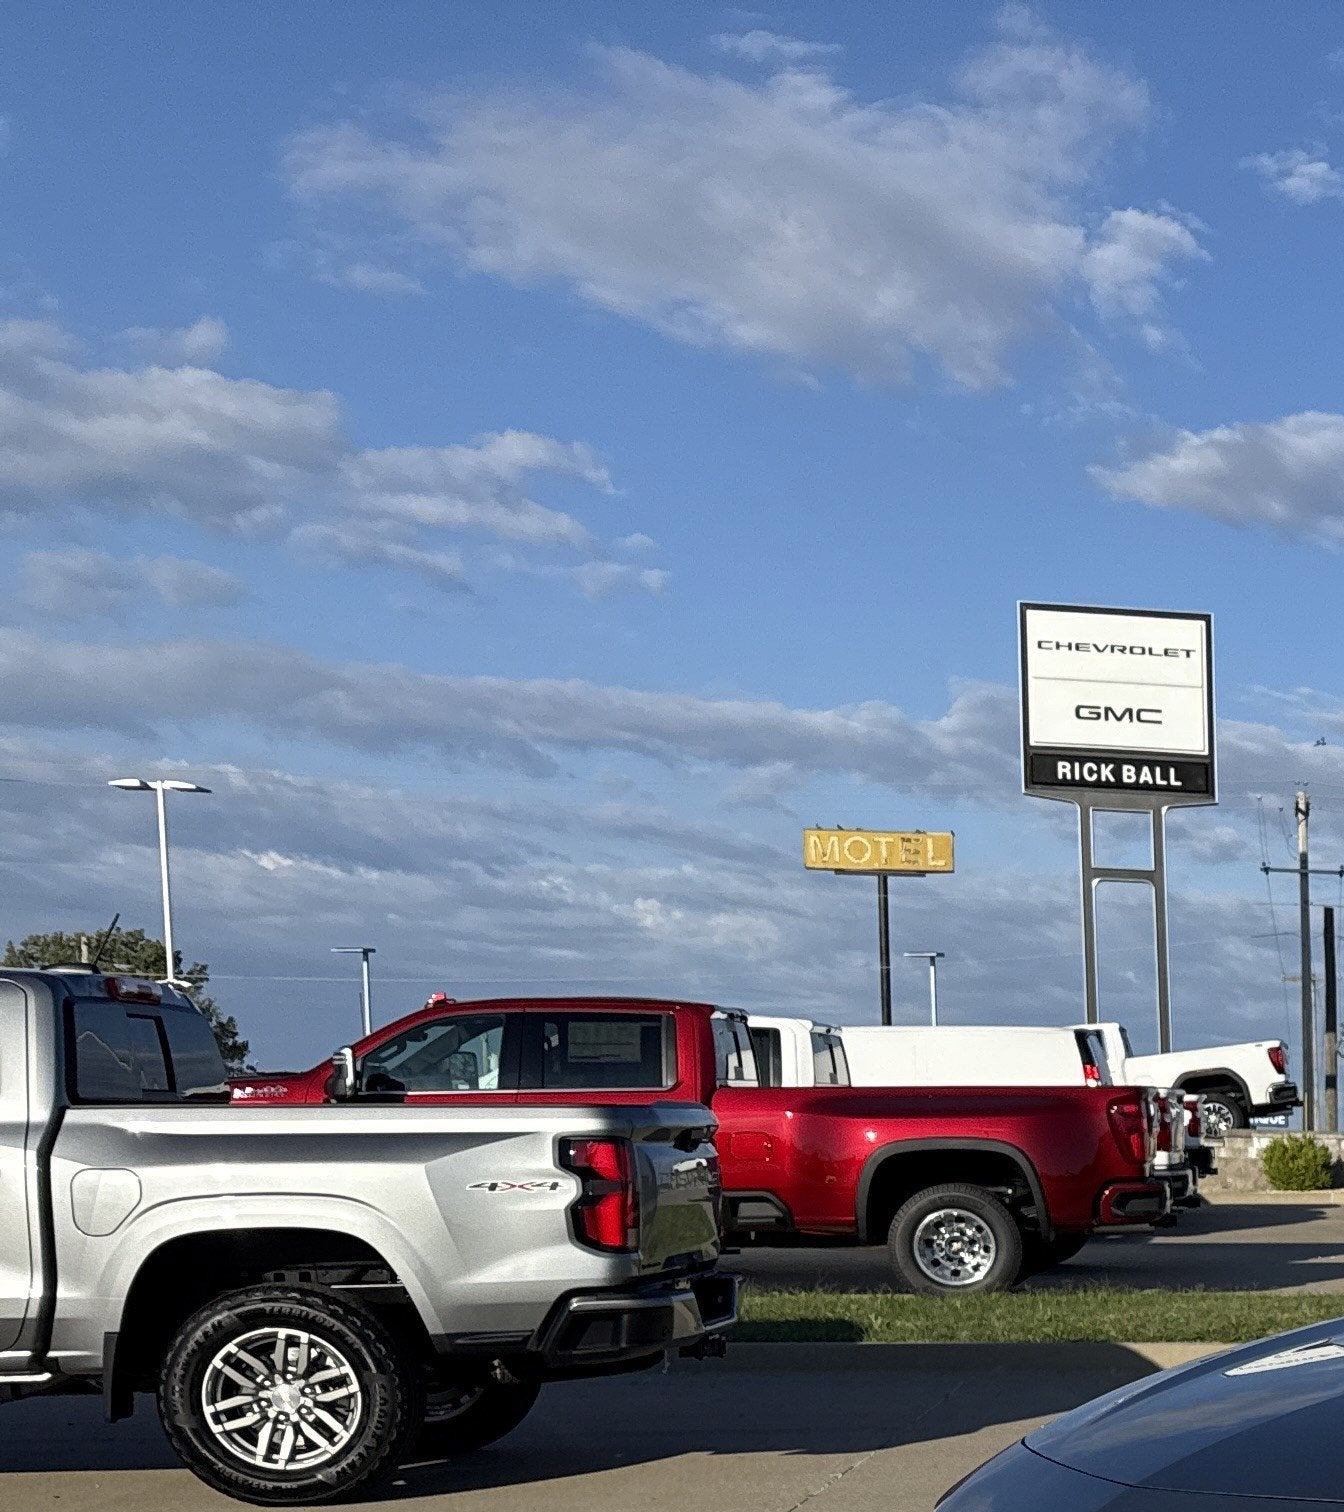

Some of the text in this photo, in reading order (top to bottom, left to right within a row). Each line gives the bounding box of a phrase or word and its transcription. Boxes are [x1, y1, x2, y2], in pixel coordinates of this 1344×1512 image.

[1037, 640, 1196, 659] CHEVROLET
[1074, 704, 1163, 725] GMC
[1057, 761, 1183, 786] RICK BALL
